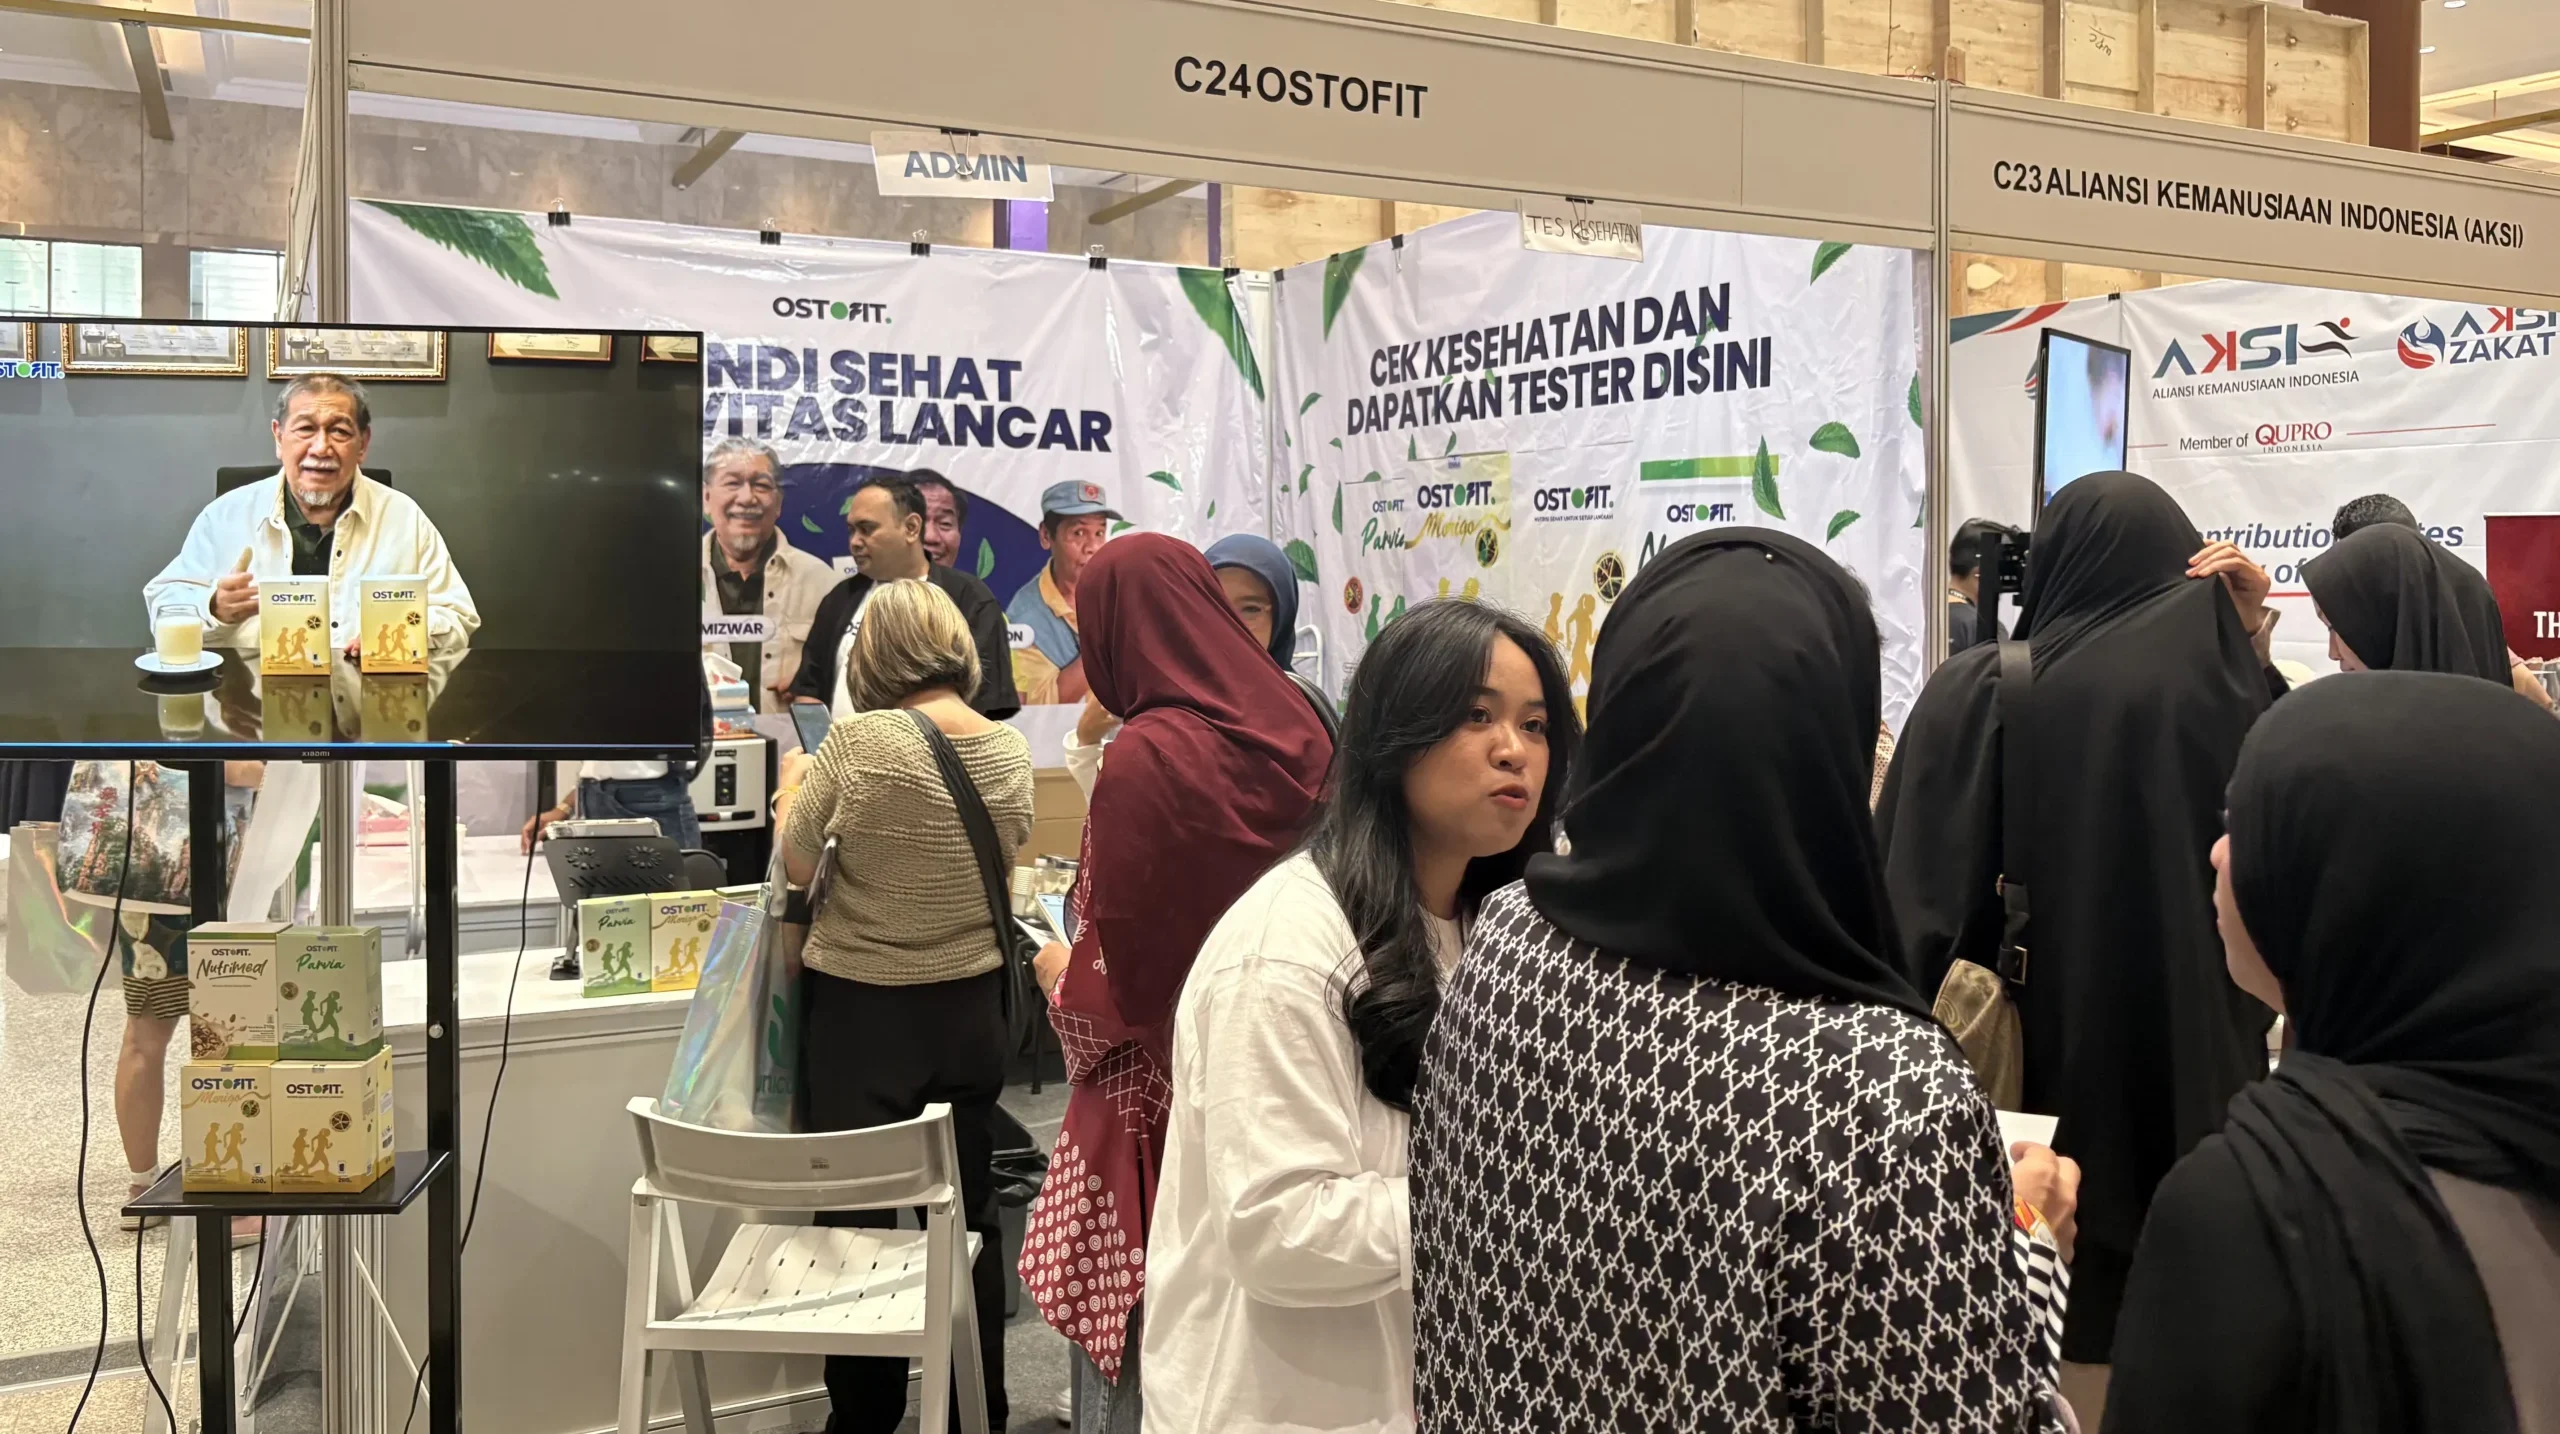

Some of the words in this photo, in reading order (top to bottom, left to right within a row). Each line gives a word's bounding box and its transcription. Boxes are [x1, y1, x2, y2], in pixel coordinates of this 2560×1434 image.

[1174, 56, 1251, 99] C24
[1256, 66, 1428, 118] OSTOFIT
[903, 150, 1028, 183] ADMIN
[1993, 160, 2042, 193] C23
[2045, 167, 2149, 206] ALIANSI
[2157, 181, 2332, 225] KEMANUSIAAN
[2340, 202, 2459, 241] INDONESIA
[2464, 217, 2524, 250] (AKSI)
[1526, 214, 1565, 238] TES
[1569, 219, 1640, 244] KESEHATAN
[1369, 340, 1420, 388] CEK
[1425, 301, 1625, 379] KESEHATAN
[1633, 282, 1731, 346] DAN
[2152, 323, 2299, 379] AKSI
[2449, 331, 2557, 364] ZAKAT
[707, 342, 819, 392] NDI
[830, 350, 1022, 403] SEHAT
[1347, 376, 1502, 436] DAPATKAN
[1508, 356, 1635, 417] TESTER
[1642, 335, 1772, 401] DISINI
[2152, 385, 2195, 400] ALIANSI
[2198, 376, 2286, 396] KEMANUSIAAN
[2289, 370, 2360, 388] INDONESIA
[879, 399, 1112, 453] LANCAR
[2179, 435, 2233, 451] Member
[2236, 433, 2249, 448] of
[2255, 420, 2333, 446] QUPRO
[2263, 443, 2324, 454] INDONESIA
[701, 622, 763, 635] MIZWAR
[196, 958, 269, 980] Nutrimeal
